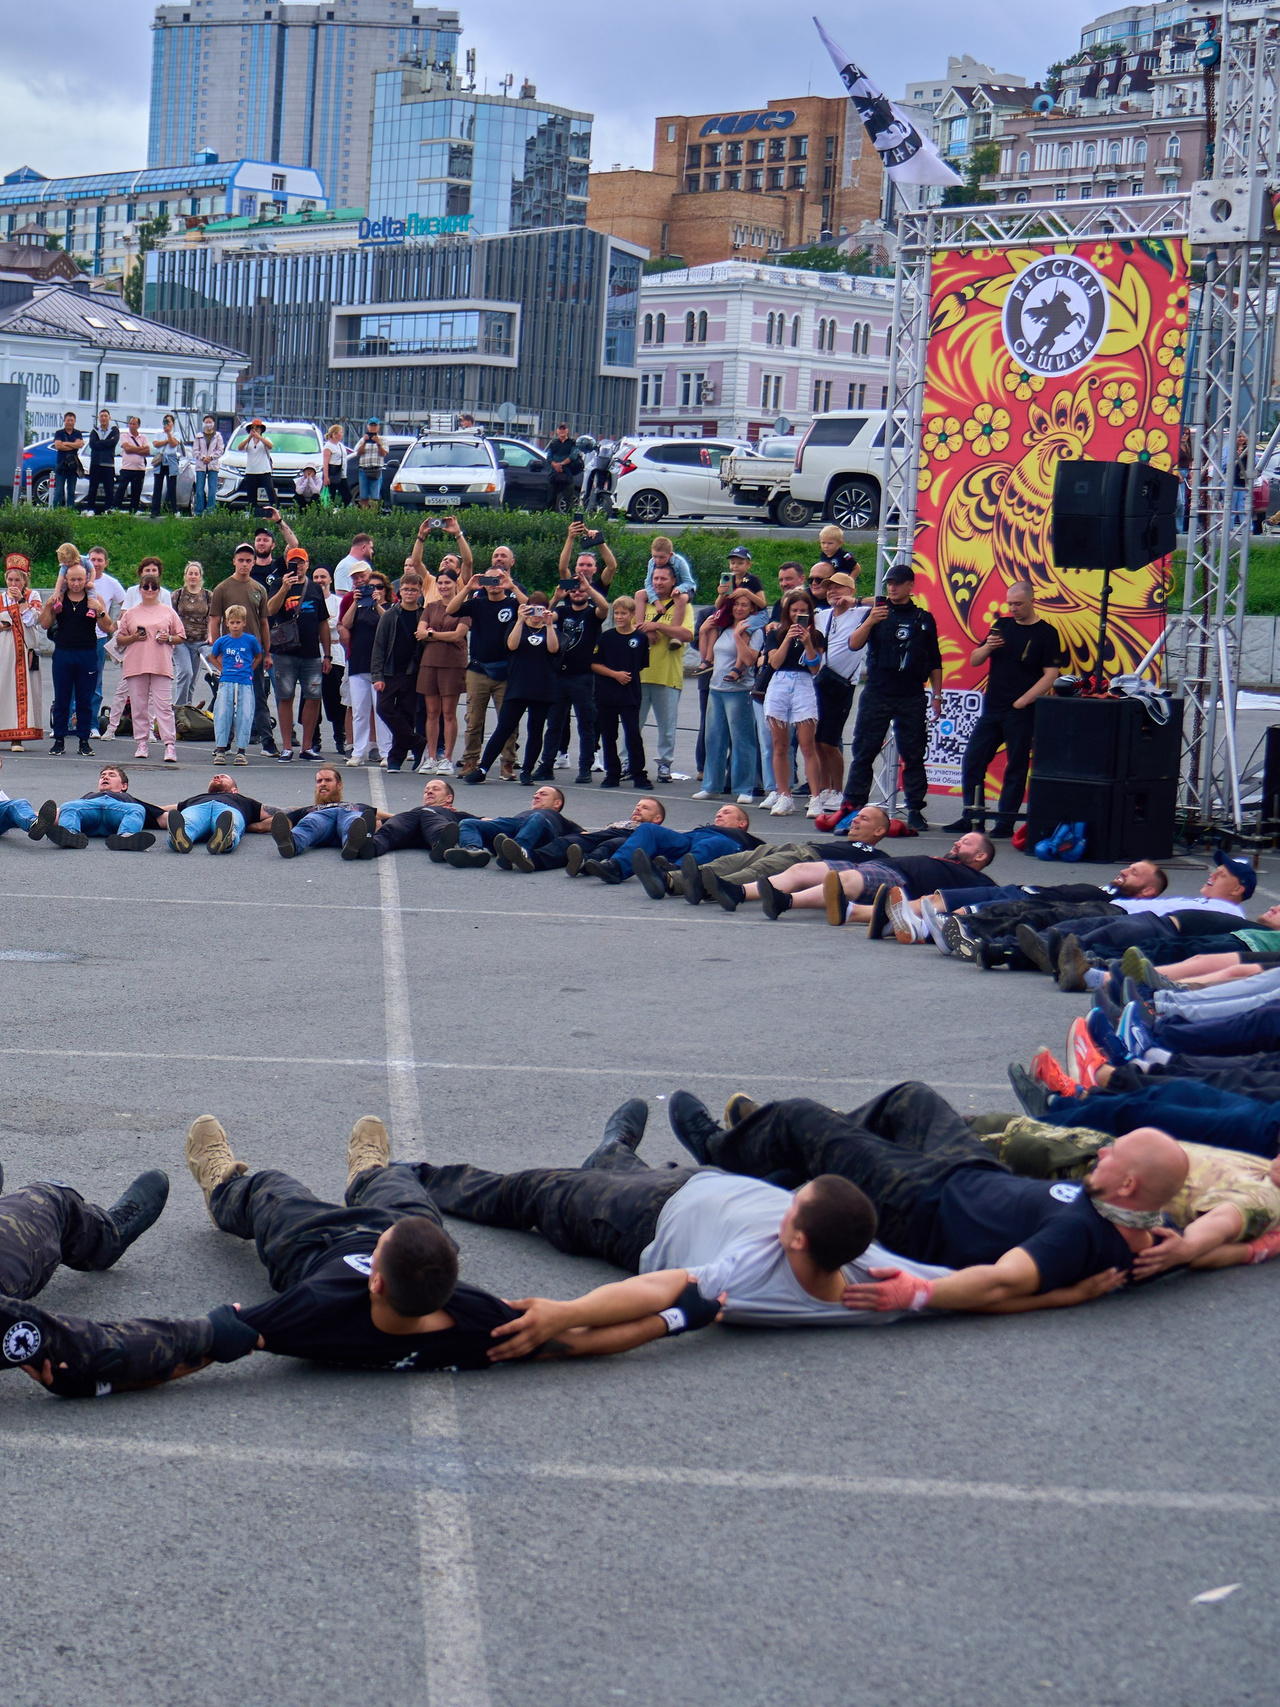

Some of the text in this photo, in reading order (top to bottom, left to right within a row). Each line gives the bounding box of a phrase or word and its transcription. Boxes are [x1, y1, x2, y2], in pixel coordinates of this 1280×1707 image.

[1012, 261, 1100, 301] РУССКАЯ
[1013, 337, 1094, 371] ОБЩИНА
[942, 777, 961, 785] Общи
